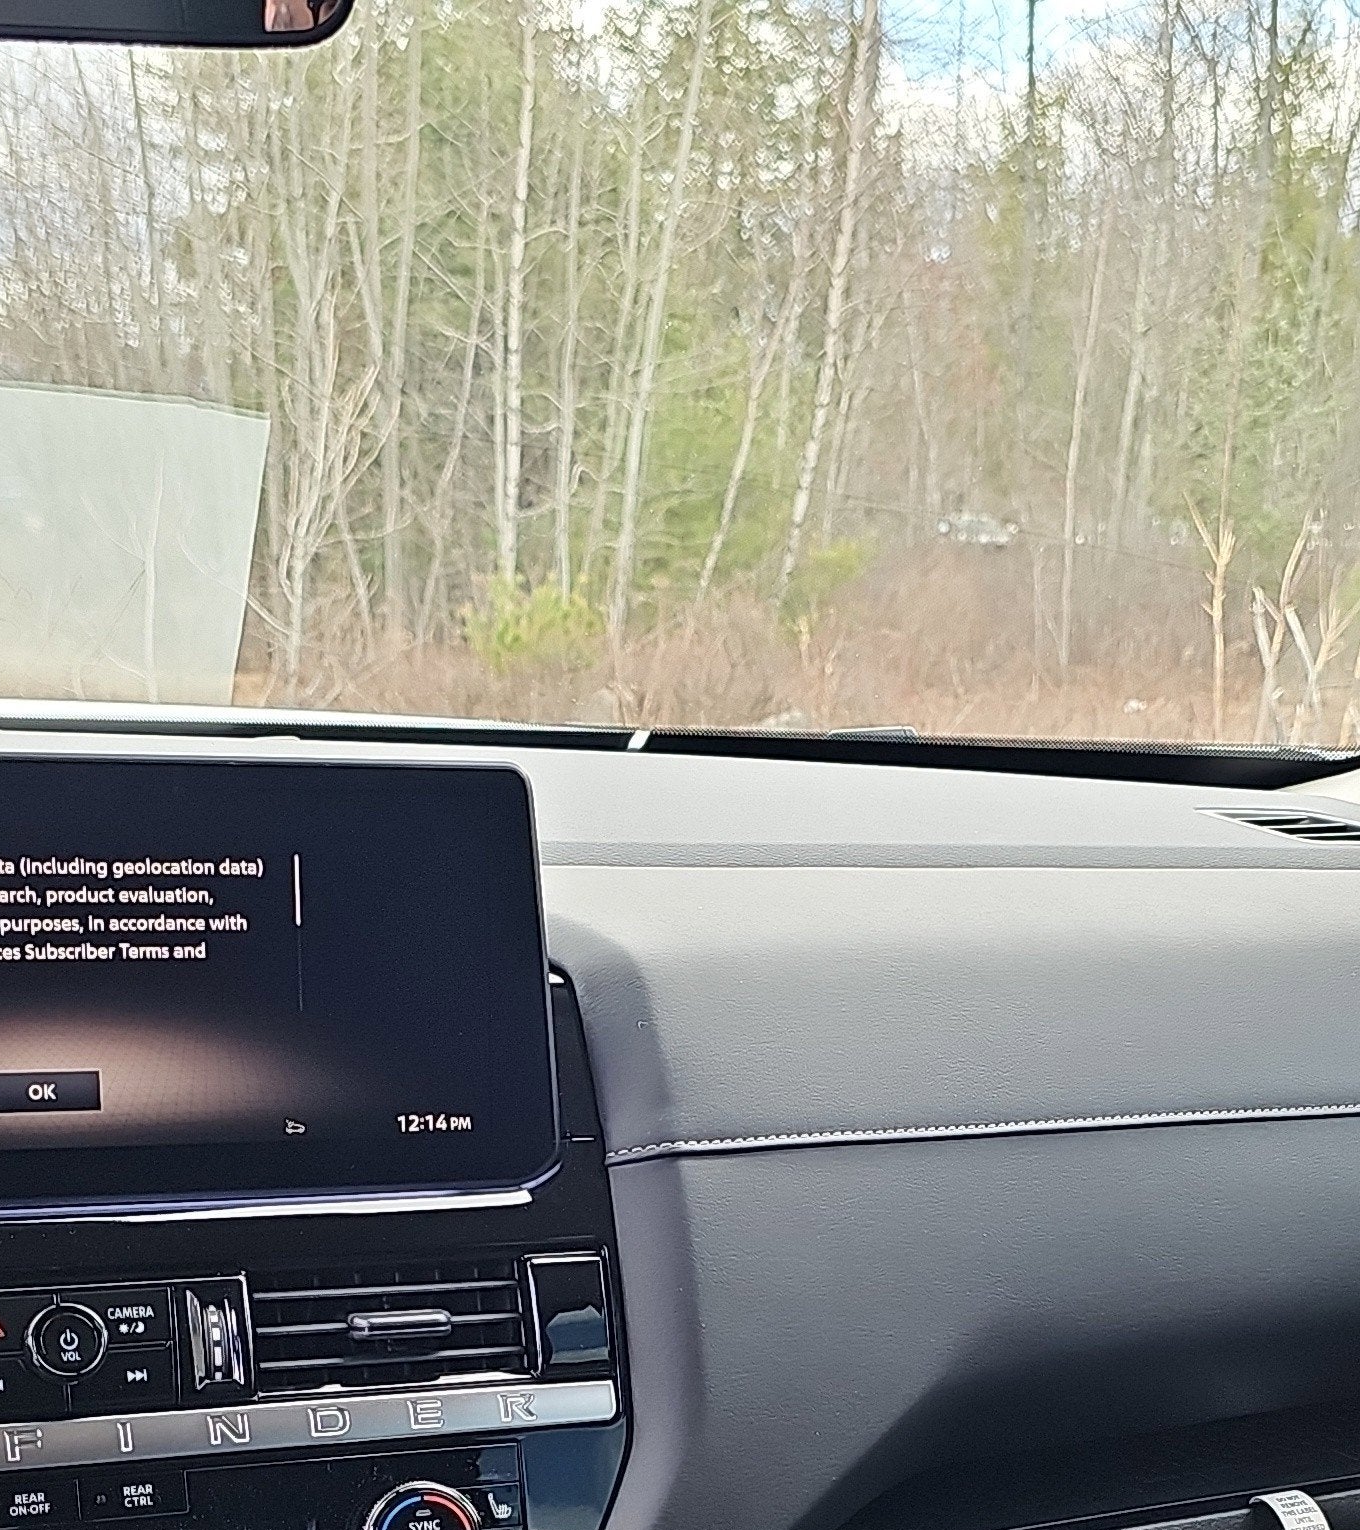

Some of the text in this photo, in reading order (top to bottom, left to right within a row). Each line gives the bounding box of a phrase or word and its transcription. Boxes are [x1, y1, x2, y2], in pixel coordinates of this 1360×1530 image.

[19, 856, 108, 879] (including
[112, 857, 215, 879] geolocation
[218, 857, 264, 878] data)
[45, 885, 116, 908] product
[118, 885, 214, 906] evaluation,
[0, 918, 84, 936] purposes,
[87, 914, 105, 932] in
[108, 913, 206, 932] accordance
[208, 913, 248, 932] with
[24, 942, 117, 960] Subscriber
[118, 942, 170, 960] Terms
[172, 941, 207, 959] and
[28, 1083, 57, 1101] OK
[397, 1113, 472, 1133] 12:14 PM
[107, 1305, 155, 1320] CAMERA
[60, 1347, 82, 1362] VOL
[122, 1483, 154, 1497] REAR
[14, 1492, 45, 1507] REAR
[123, 1493, 154, 1508] CTRL
[1297, 1507, 1318, 1515] LABEL
[1295, 1516, 1314, 1524] UNTIL
